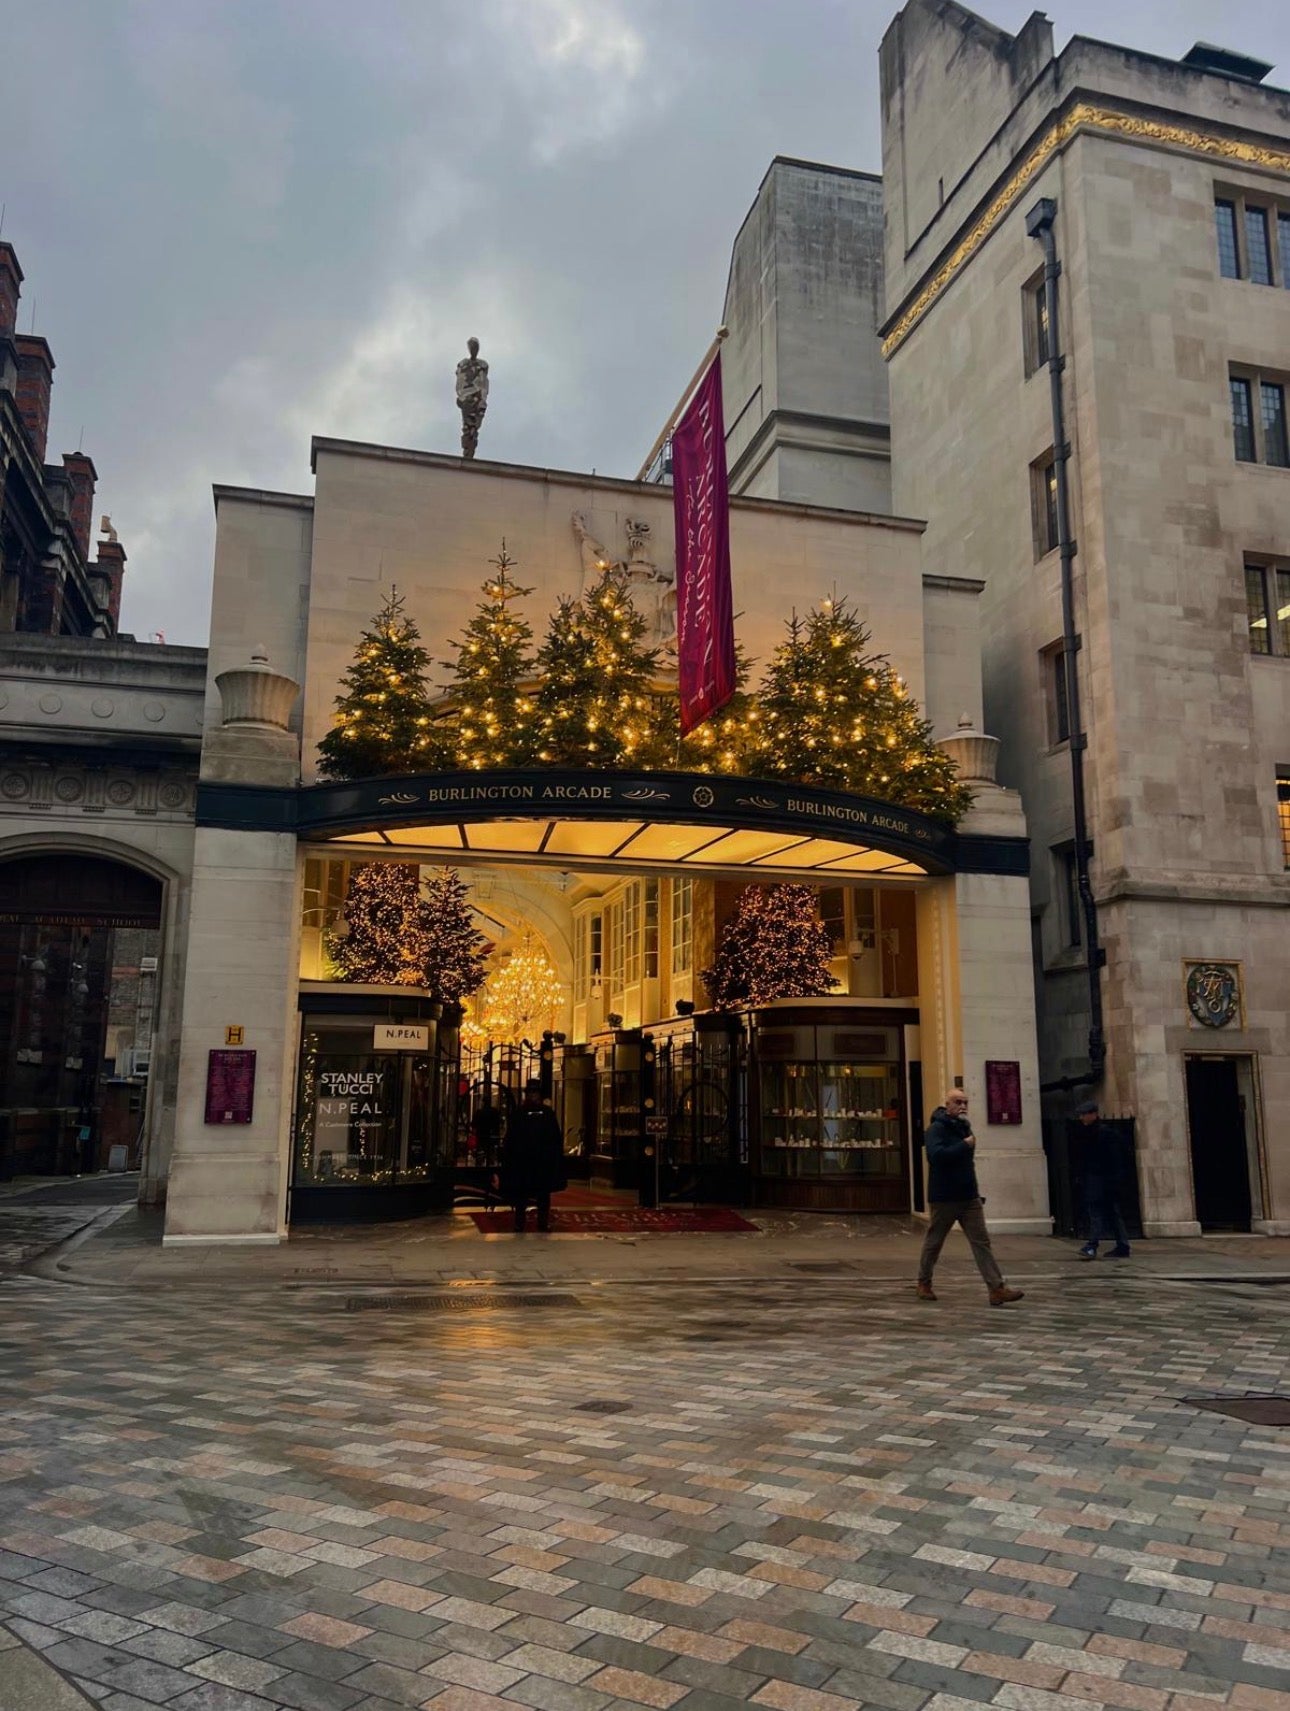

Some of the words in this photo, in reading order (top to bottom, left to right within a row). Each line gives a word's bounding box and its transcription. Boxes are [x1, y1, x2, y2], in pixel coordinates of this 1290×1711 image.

[686, 528, 695, 563] the
[694, 473, 706, 628] ARCADE
[429, 786, 534, 801] BURLINGTON
[542, 786, 612, 799] ARCADE
[787, 799, 868, 824] BURLINGTON
[871, 815, 909, 834] ARCADE
[228, 1026, 241, 1042] H
[386, 1029, 421, 1039] N.PEAL
[320, 1072, 384, 1084] STANLEY
[327, 1083, 373, 1095] TUCCI
[319, 1102, 382, 1114] N.PEAL
